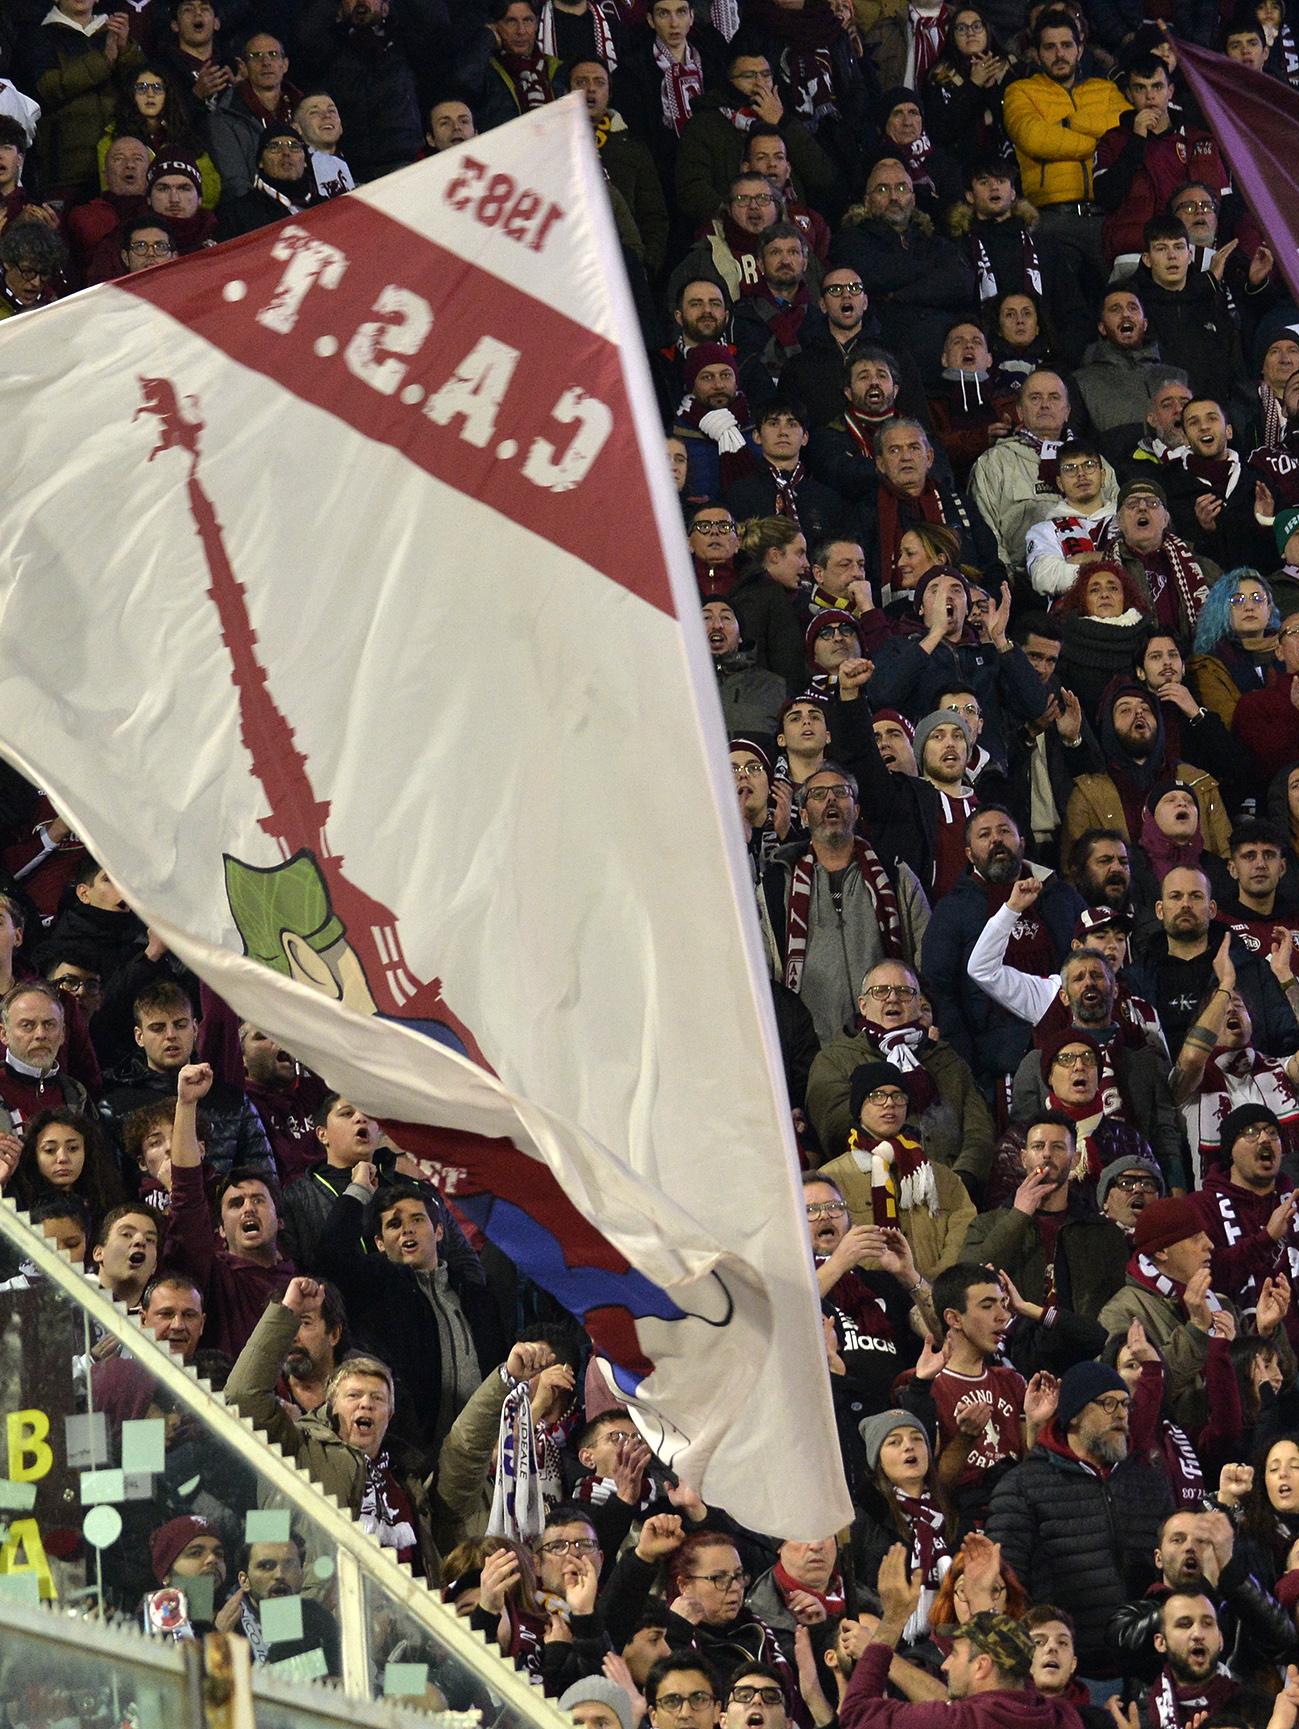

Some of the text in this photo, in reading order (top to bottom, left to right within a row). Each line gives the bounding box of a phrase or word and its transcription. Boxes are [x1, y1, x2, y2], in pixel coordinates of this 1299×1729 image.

[843, 1329, 898, 1356] didas
[998, 1397, 1014, 1417] FC
[5, 1409, 54, 1483] B
